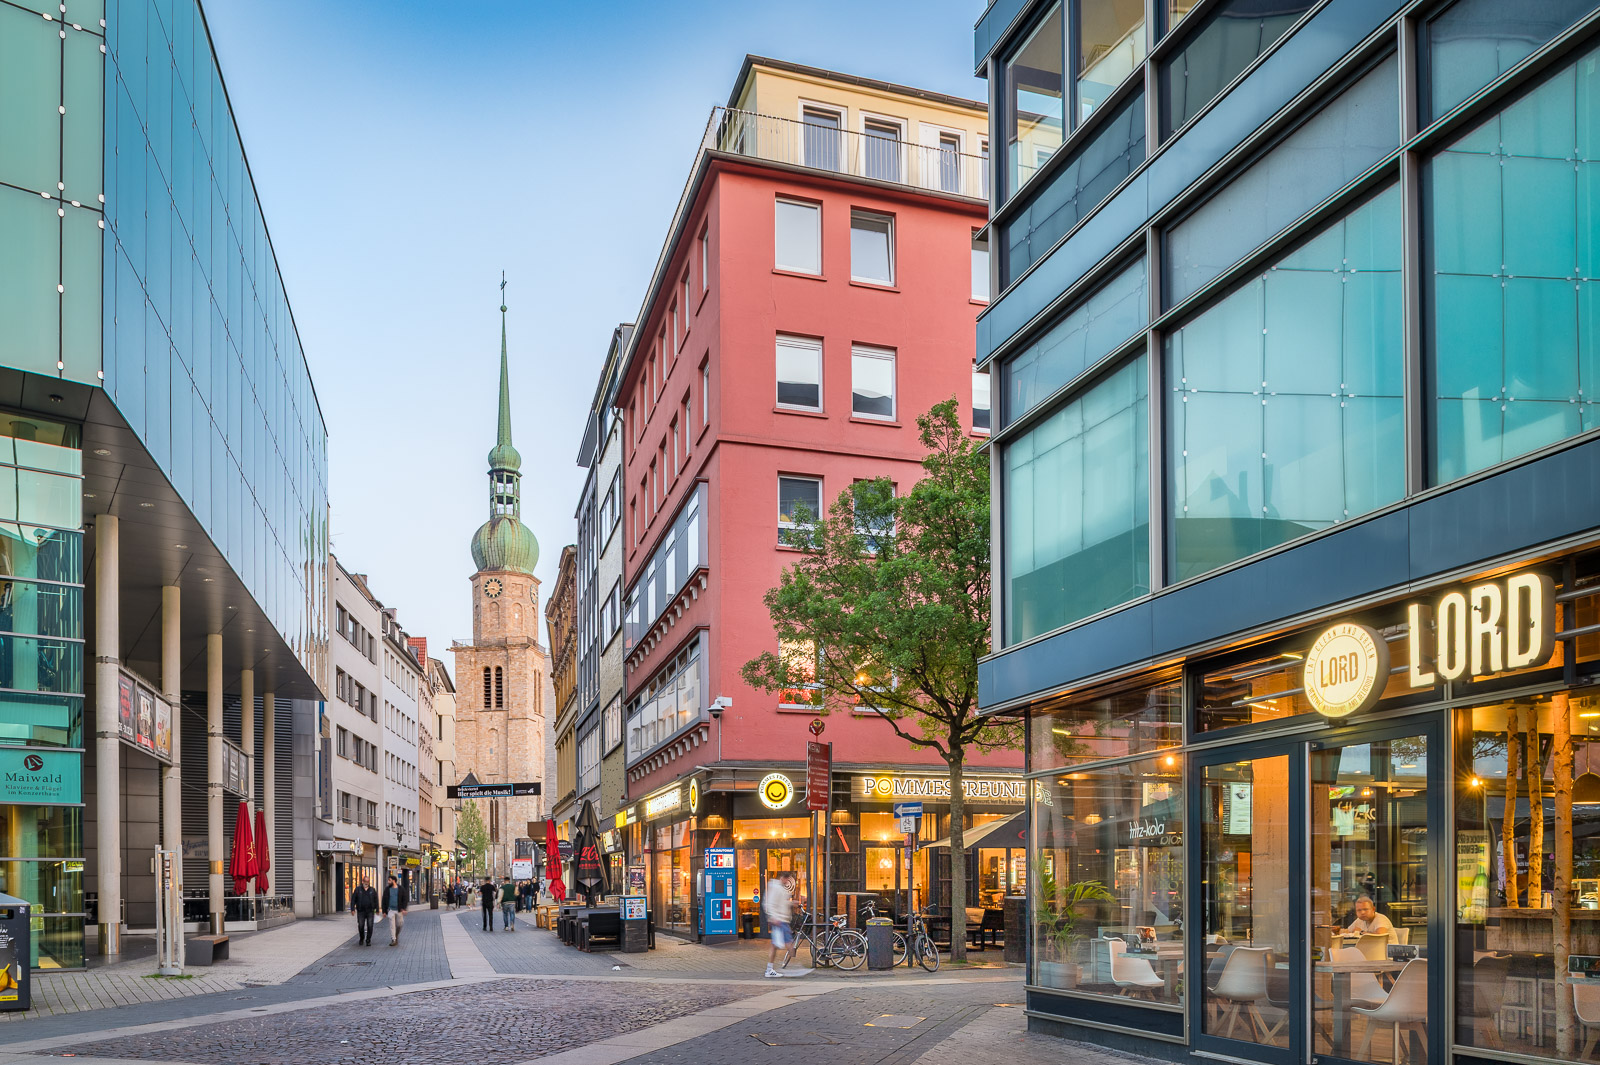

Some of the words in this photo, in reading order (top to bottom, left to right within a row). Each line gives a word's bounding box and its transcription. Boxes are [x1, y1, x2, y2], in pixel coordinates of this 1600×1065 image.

[1408, 573, 1544, 688] LORD
[1307, 657, 1315, 674] EAT
[1315, 629, 1337, 652] CLEAN
[1342, 626, 1357, 636] AND
[1360, 633, 1376, 660] GREEN
[1320, 652, 1359, 688] LORD
[1348, 700, 1360, 709] AND
[5, 772, 62, 783] Maiwald
[760, 774, 776, 794] POMMES
[776, 774, 793, 793] FREUNDE
[1129, 817, 1165, 839] fritz-kola
